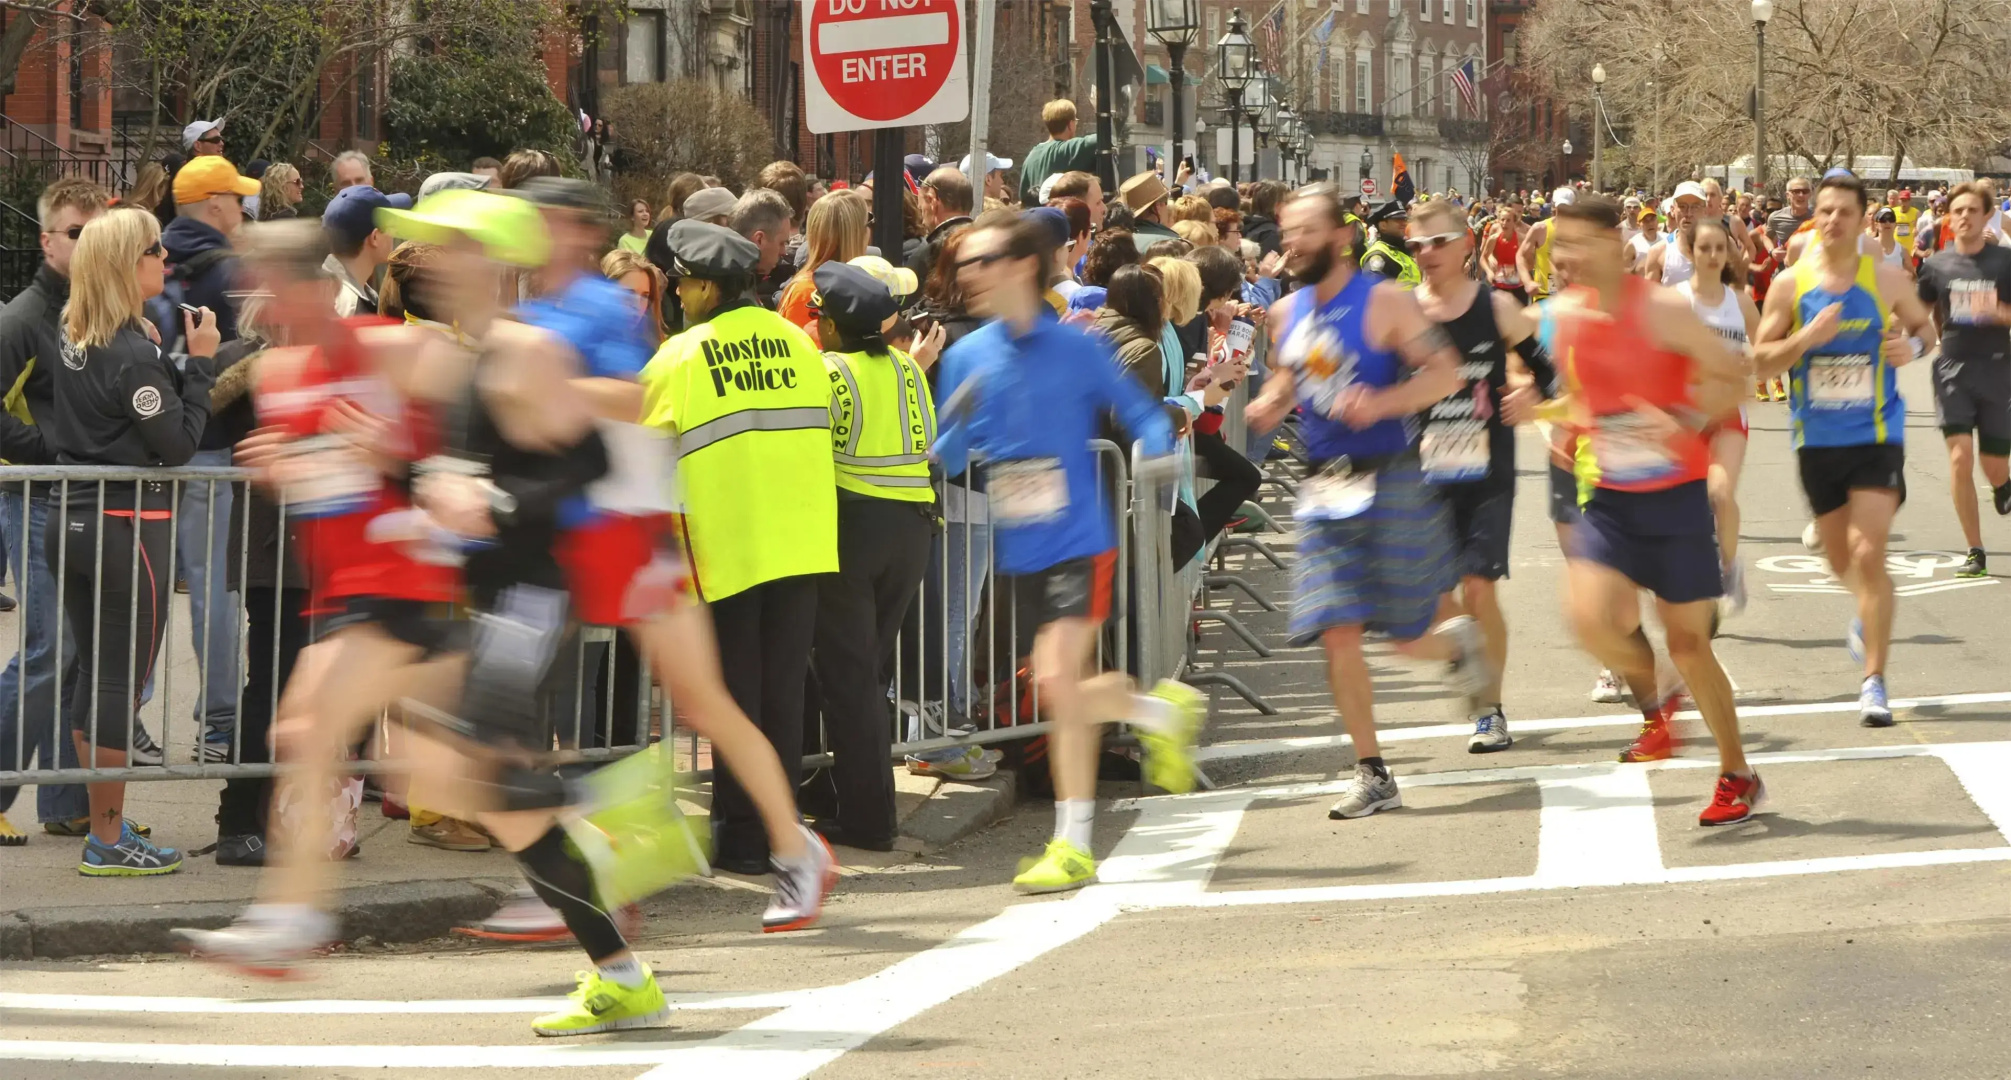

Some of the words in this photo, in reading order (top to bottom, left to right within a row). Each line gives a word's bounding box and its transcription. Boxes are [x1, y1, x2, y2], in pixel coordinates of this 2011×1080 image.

[842, 53, 927, 83] ENTER
[700, 331, 791, 367] Boston
[710, 361, 797, 398] Police
[135, 393, 154, 403] TEAM
[902, 364, 924, 451] POLICE
